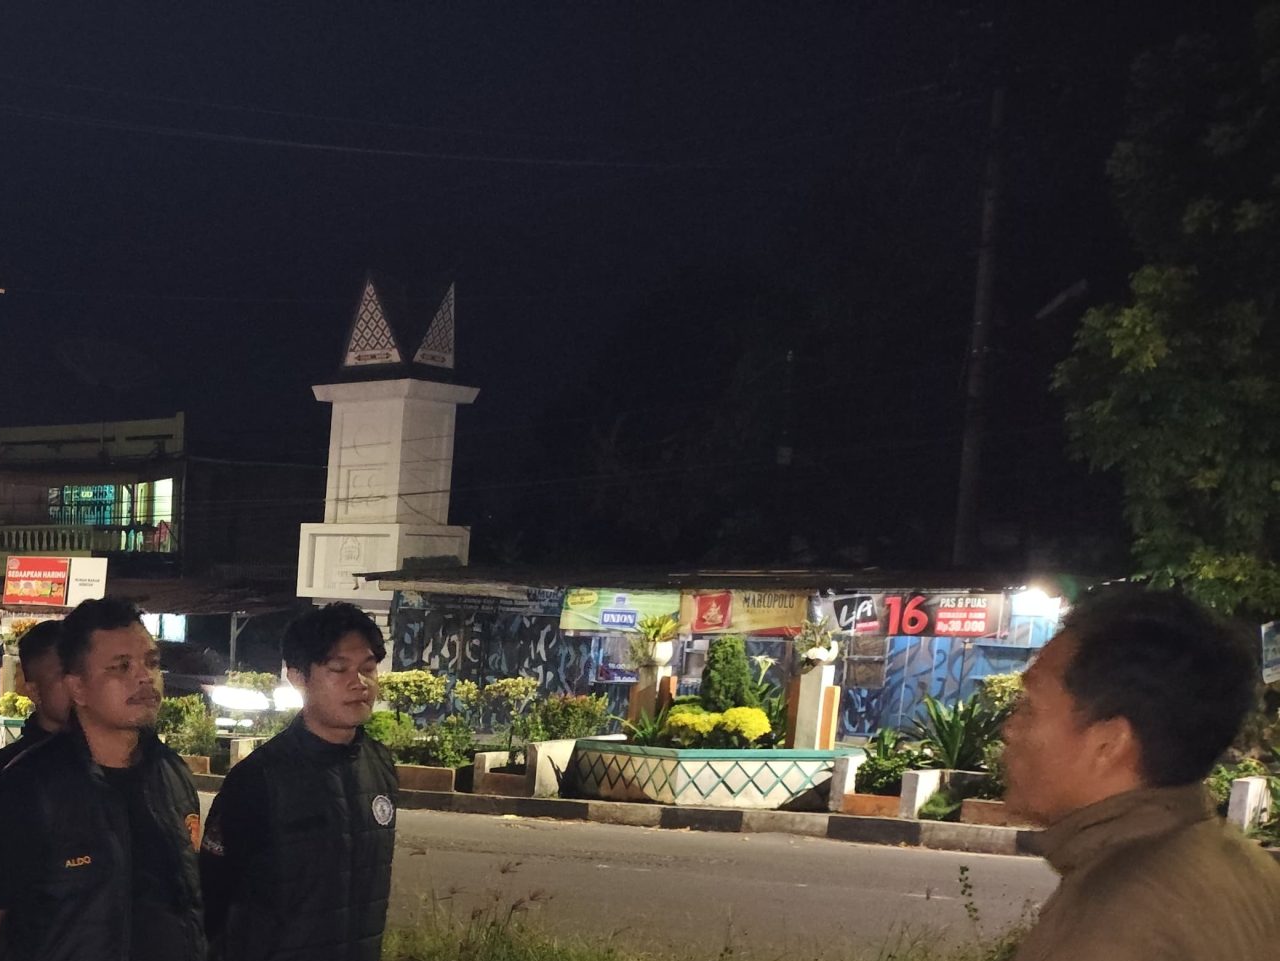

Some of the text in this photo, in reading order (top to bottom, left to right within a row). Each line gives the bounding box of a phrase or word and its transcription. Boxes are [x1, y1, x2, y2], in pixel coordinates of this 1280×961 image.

[7, 570, 66, 579] SEDAAPKAN HARIMU
[742, 592, 795, 609] MARCOPOLO
[939, 598, 956, 608] PAS
[964, 598, 987, 608] PUAS
[603, 613, 635, 624] UNION
[885, 595, 929, 636] 16
[64, 855, 92, 869] ALDO
